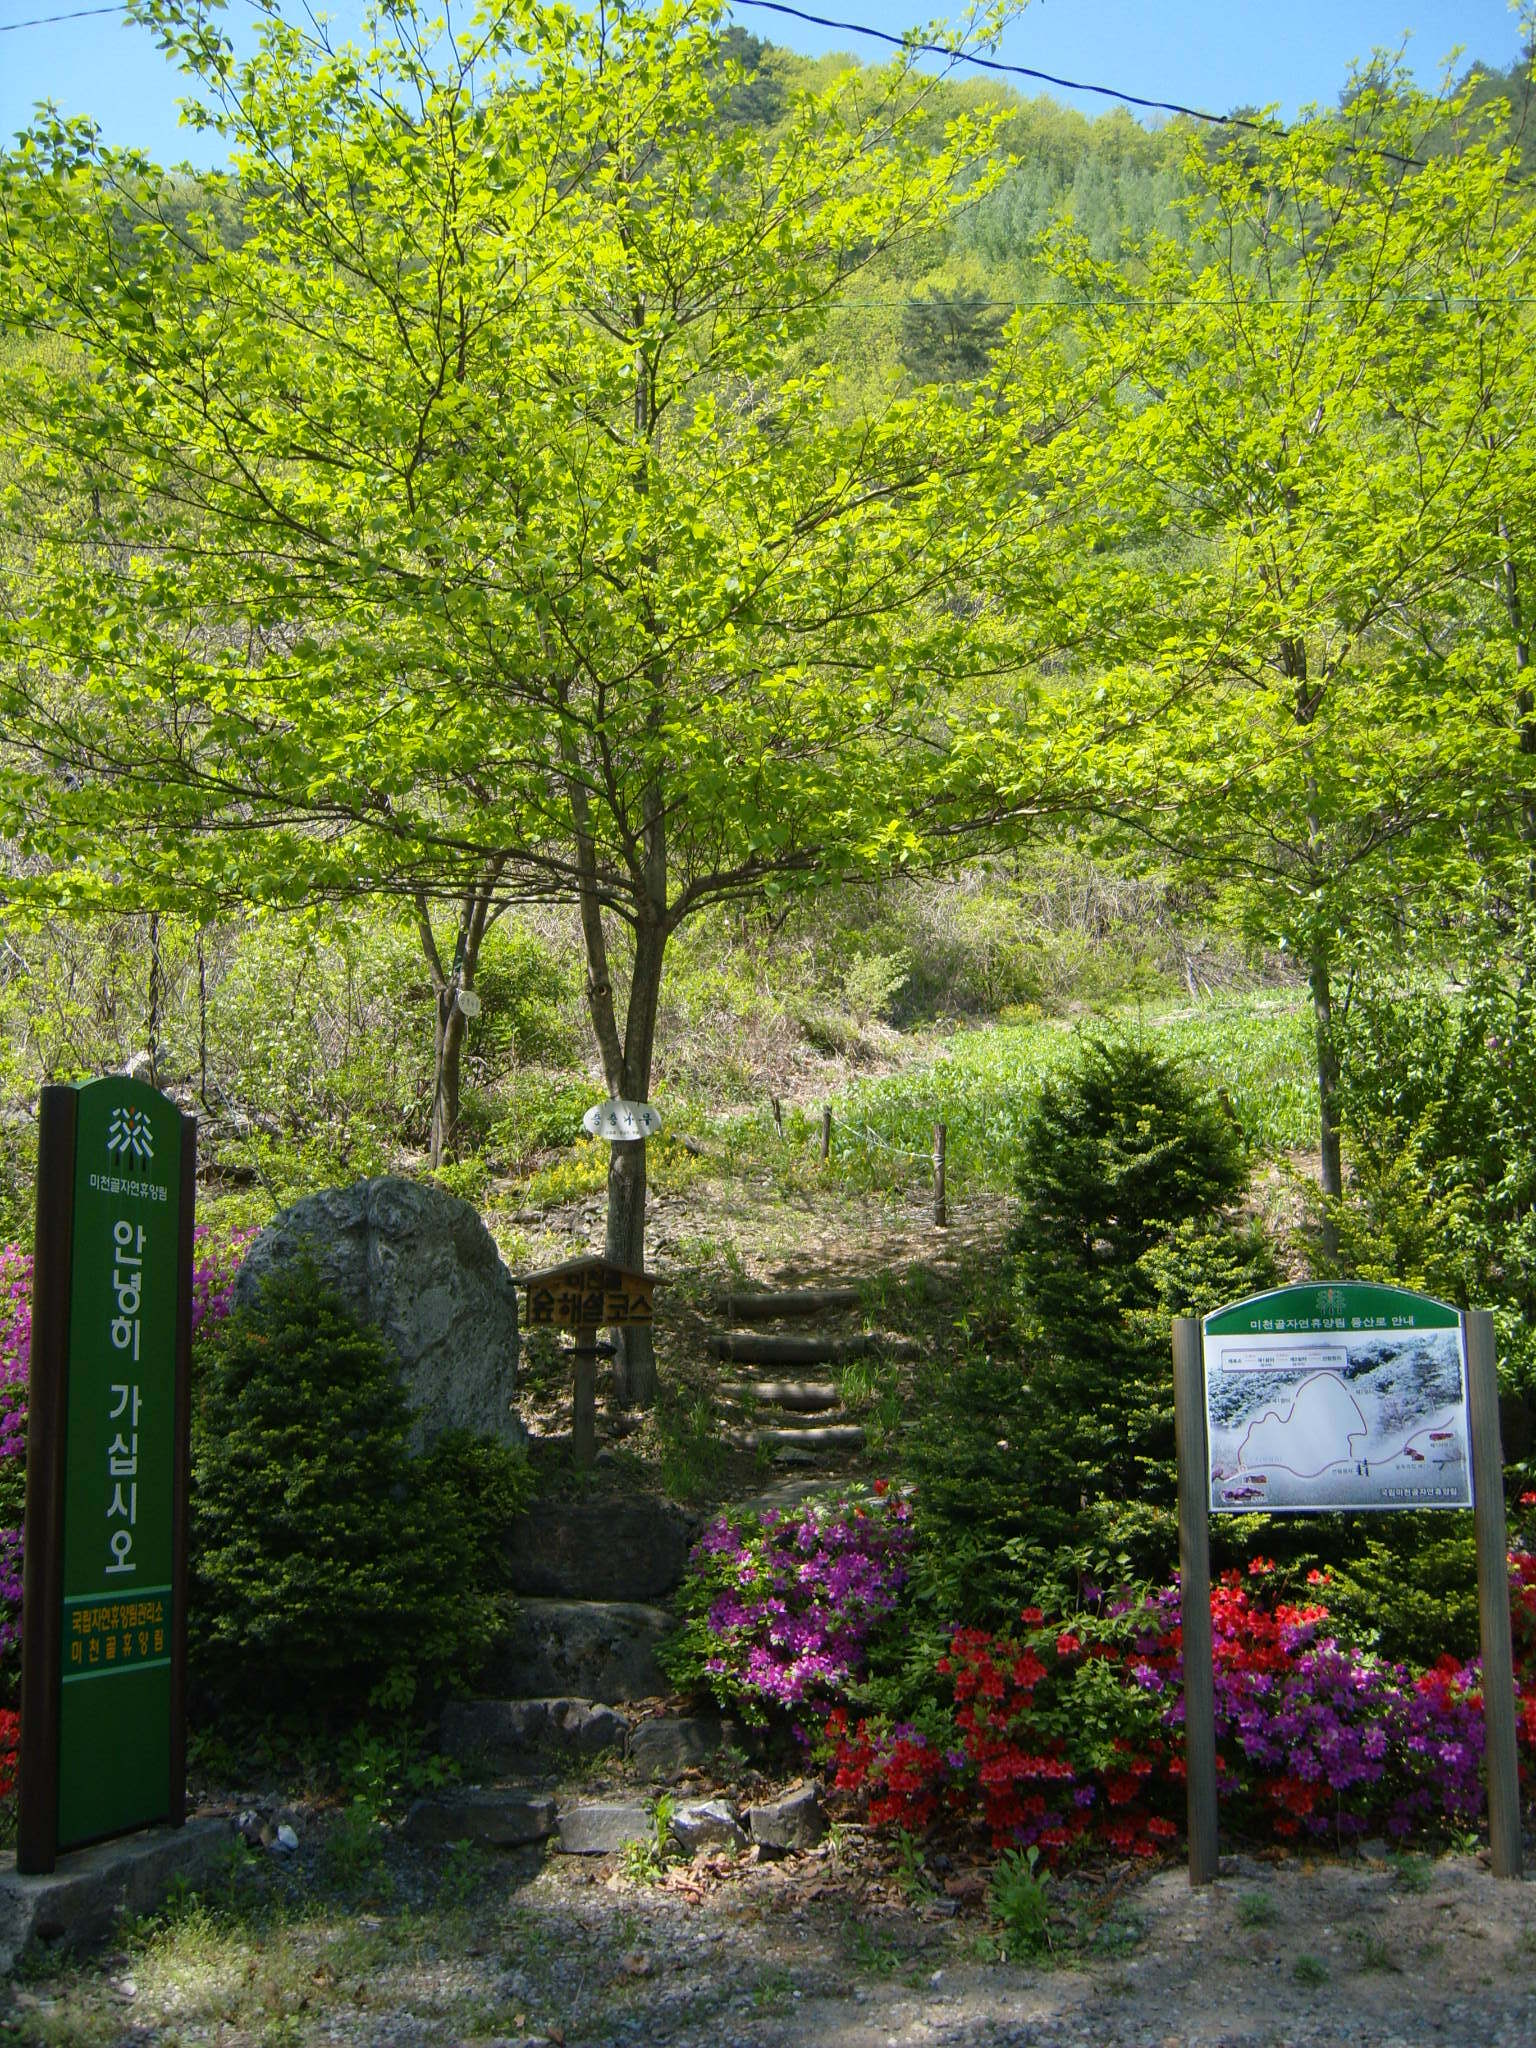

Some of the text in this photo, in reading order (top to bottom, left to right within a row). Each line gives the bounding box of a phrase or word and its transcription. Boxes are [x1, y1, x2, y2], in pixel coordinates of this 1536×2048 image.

[90, 1174, 167, 1201] 미천골자연휴양림
[1250, 1315, 1415, 1331] 미천골자연휴양림 등산로 안내
[105, 1220, 146, 1574] 안녕히 가십시오
[72, 1601, 164, 1634] 국립자연휴양림관리소
